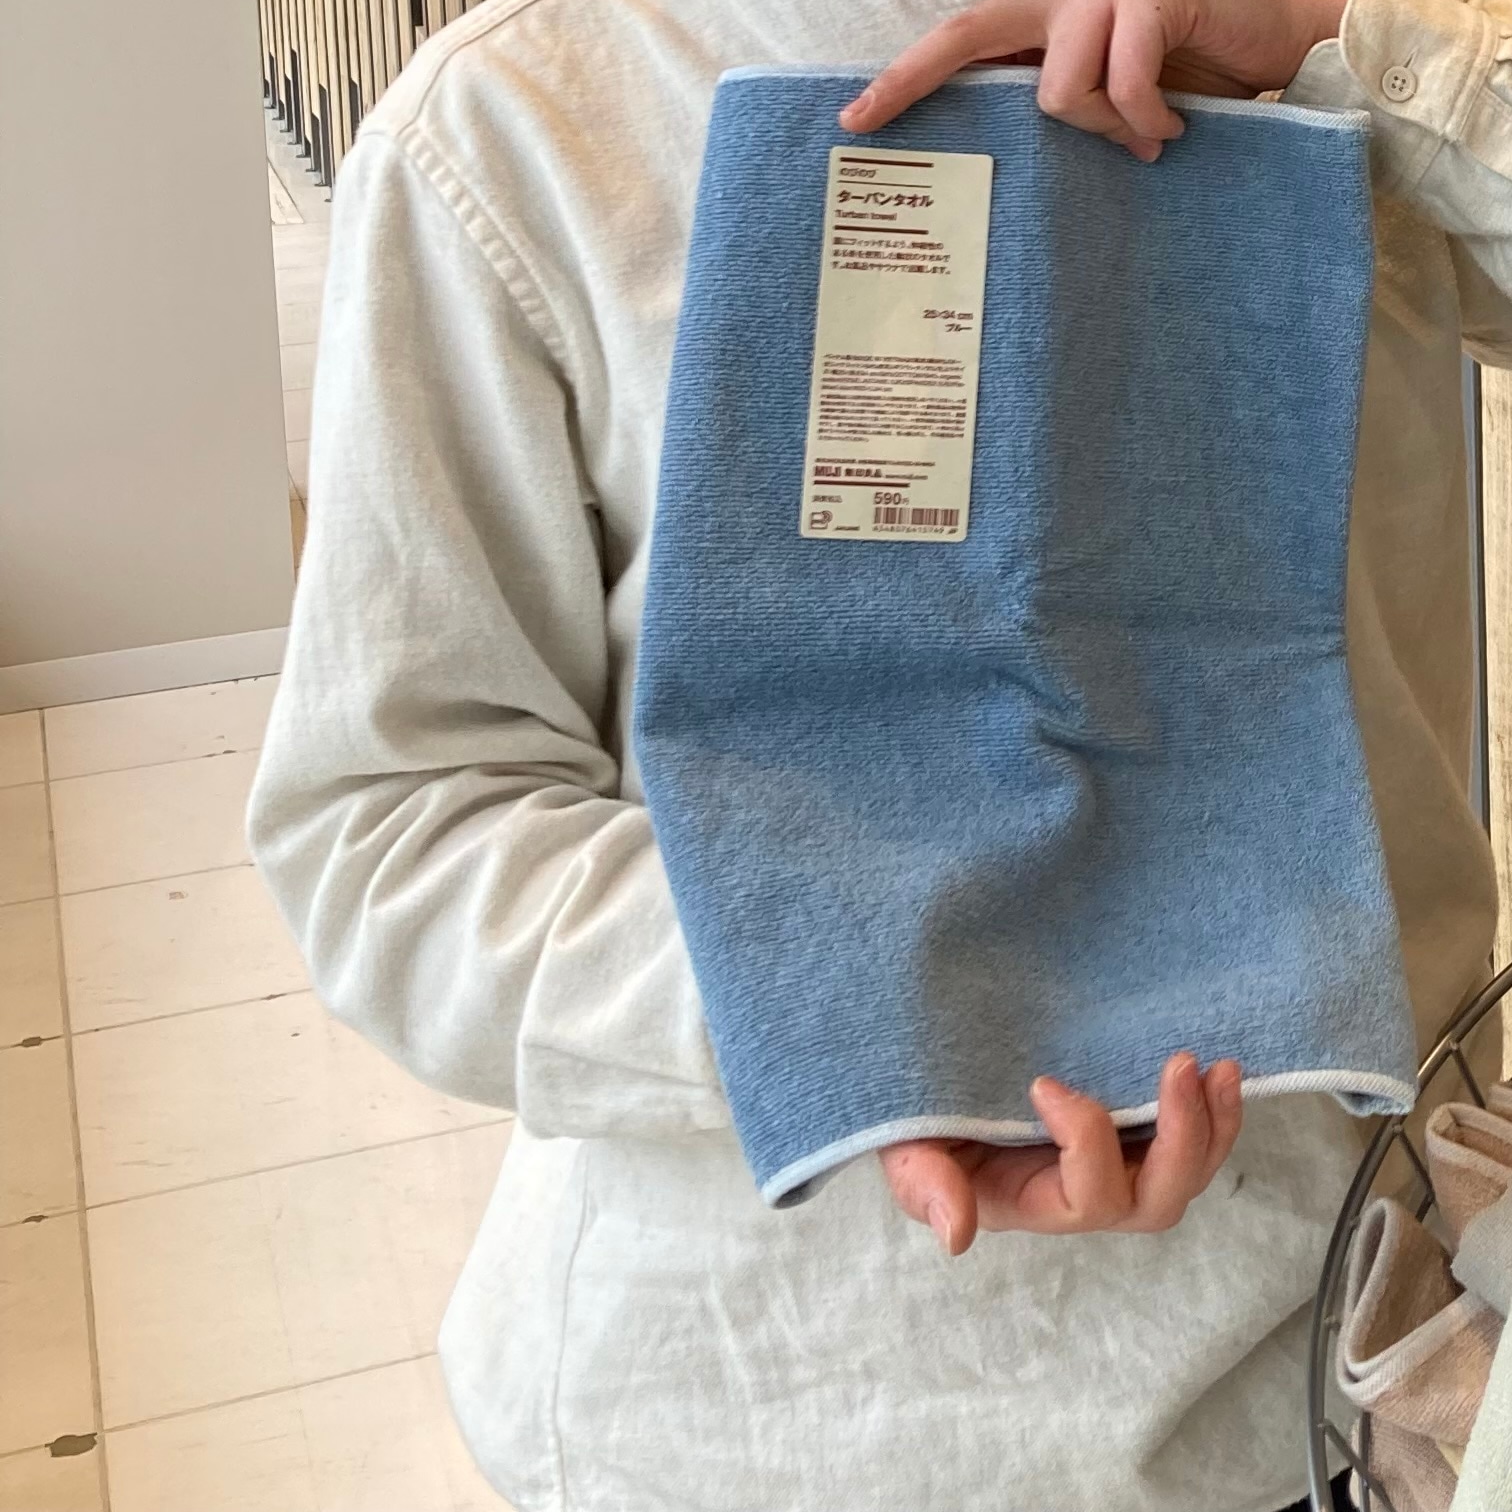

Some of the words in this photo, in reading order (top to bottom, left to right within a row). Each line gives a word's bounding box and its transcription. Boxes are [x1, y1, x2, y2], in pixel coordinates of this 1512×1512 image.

[837, 190, 934, 208] ターバンタオル
